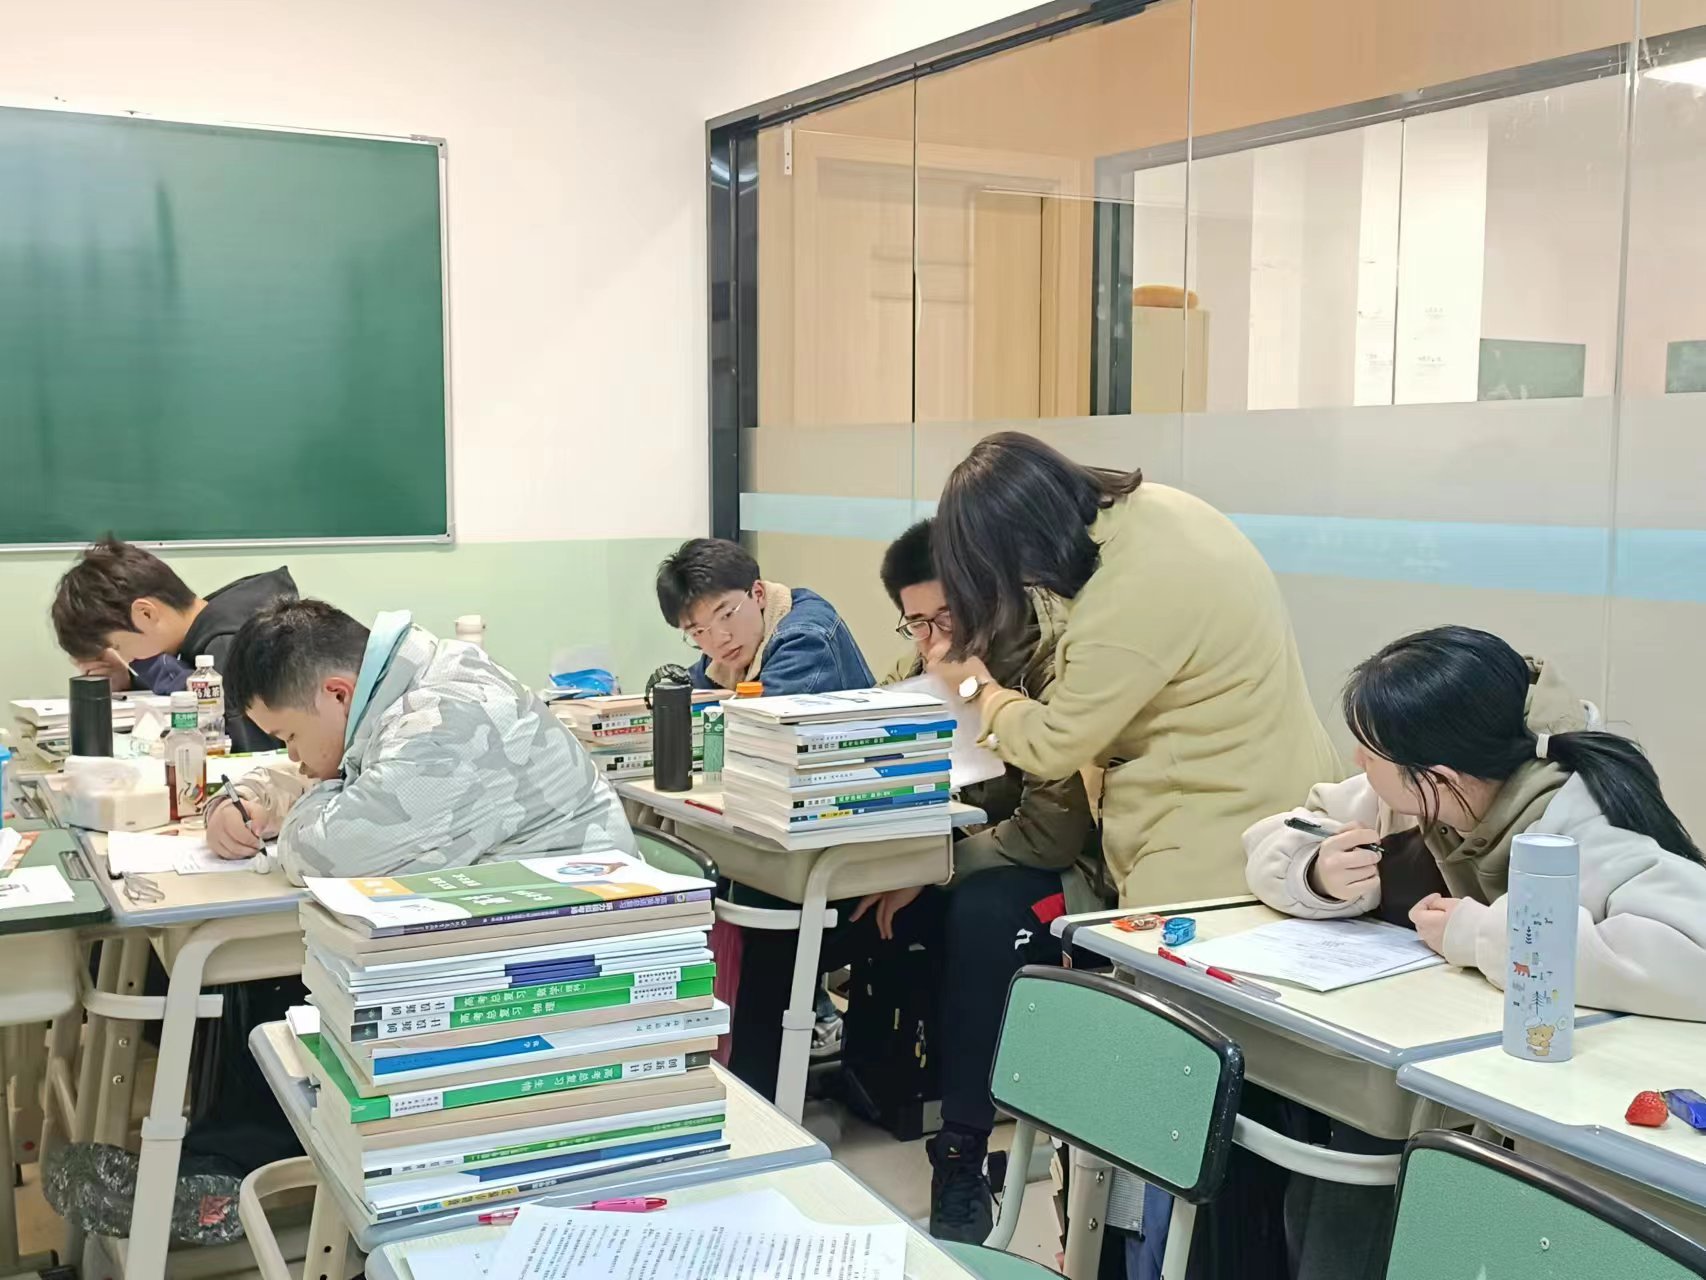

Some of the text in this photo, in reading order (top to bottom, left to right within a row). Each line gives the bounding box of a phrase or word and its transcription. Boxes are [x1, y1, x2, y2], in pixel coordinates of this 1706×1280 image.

[387, 1001, 556, 1033] 创新设计 高考总复习 物理
[391, 1001, 446, 1016] 创新设计
[464, 990, 527, 1007] 高考总复习
[521, 1058, 678, 1092] 创新设计 高考总复习 生物
